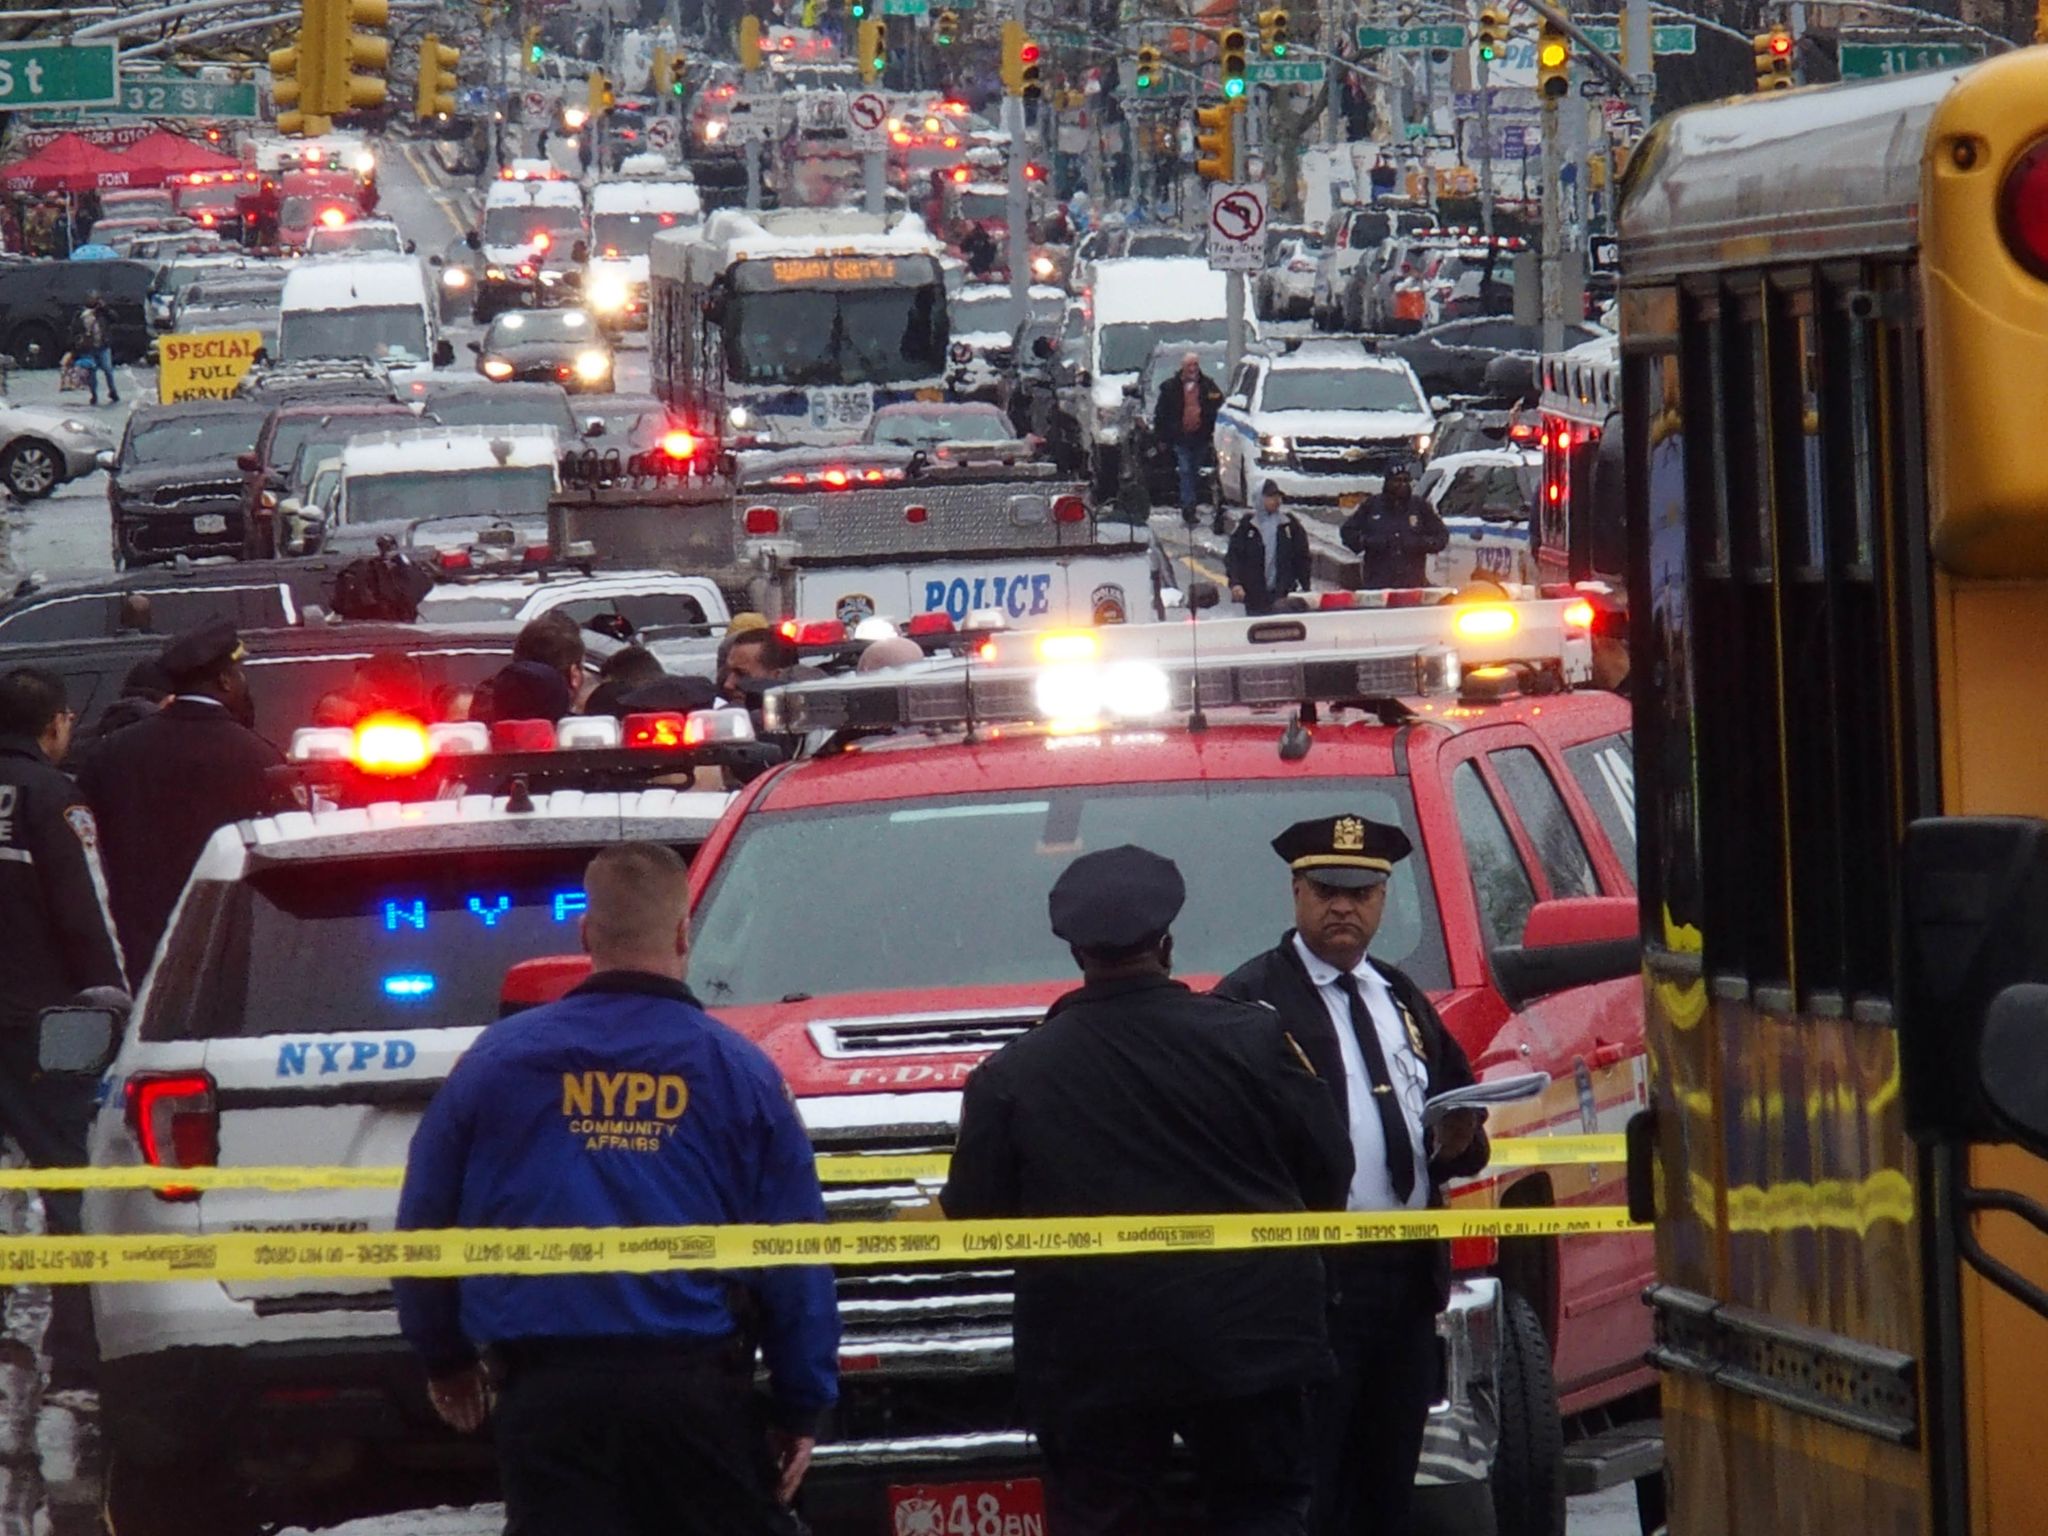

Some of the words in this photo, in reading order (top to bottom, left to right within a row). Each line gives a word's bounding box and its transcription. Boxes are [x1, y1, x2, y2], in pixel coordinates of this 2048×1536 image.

[1880, 50, 1906, 76] 31
[0, 57, 43, 96] St
[128, 87, 165, 110] 32
[180, 87, 216, 111] St
[166, 339, 253, 361] SPECIAL
[188, 364, 236, 380] FULL
[925, 573, 1050, 622] POLICE
[276, 1038, 416, 1078] NYPD
[562, 1070, 689, 1119] NYPD
[568, 1119, 678, 1136] COMMUNITY
[585, 1135, 660, 1152] AFFAIRS
[1251, 1227, 1292, 1243] CROSS
[1297, 1226, 1320, 1242] NOT
[1323, 1226, 1341, 1241] DO
[1357, 1224, 1396, 1240] SCENE
[1400, 1223, 1439, 1239] CRIME
[752, 1238, 792, 1255] CROSS
[799, 1238, 821, 1255] NOT
[823, 1237, 841, 1254] DO
[856, 1236, 897, 1254] SCENE
[898, 1234, 940, 1252] CRIME
[962, 1231, 1002, 1252] (8477)
[1006, 1230, 1103, 1251] 1-800-577-TIPS
